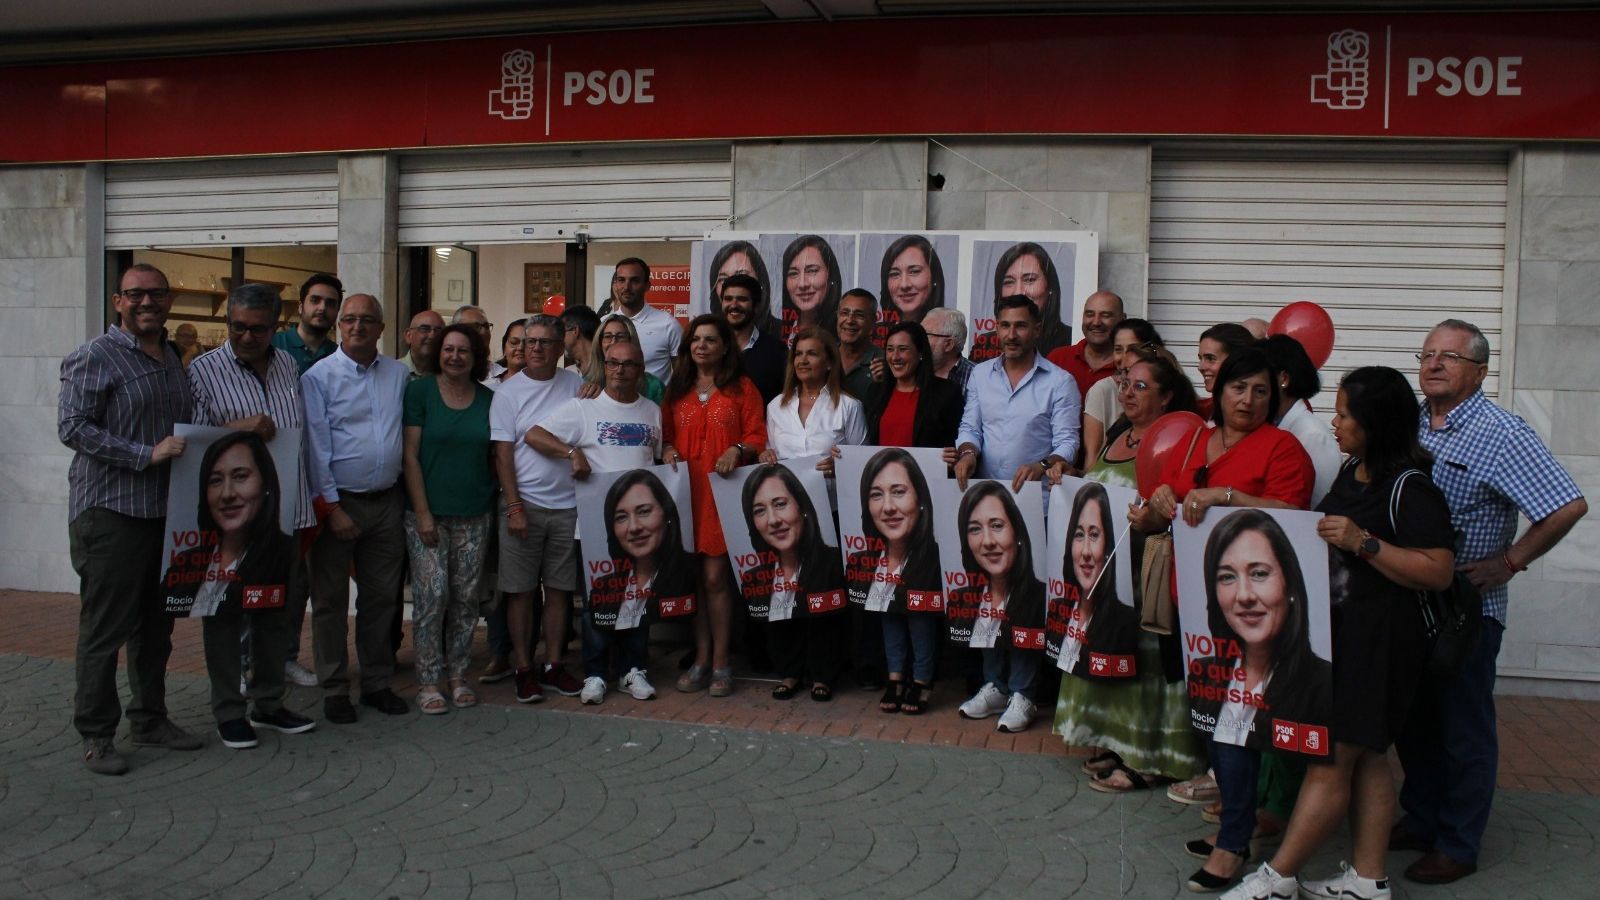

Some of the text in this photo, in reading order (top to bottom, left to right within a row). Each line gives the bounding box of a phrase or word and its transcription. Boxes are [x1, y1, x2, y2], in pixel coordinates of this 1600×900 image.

[1407, 56, 1523, 96] PSOE
[563, 68, 655, 106] PSOE
[783, 307, 799, 321] TA
[875, 309, 901, 322] OTA
[975, 318, 999, 331] VO
[172, 529, 219, 547] VOTA
[844, 534, 886, 551] VOTA
[170, 549, 223, 568] lo que
[588, 558, 634, 574] VOTA
[734, 550, 778, 568] VOTA
[845, 550, 889, 568] lo que
[590, 575, 638, 590] lo que
[739, 567, 785, 584] lo que
[944, 571, 987, 587] VOTA
[946, 587, 993, 604] lo que
[1048, 577, 1080, 602] VOTA
[1048, 595, 1081, 621] lo que
[1014, 630, 1027, 638] PSOE
[1185, 632, 1242, 659] VOTA
[1091, 656, 1107, 665] PSOE
[1187, 654, 1248, 683] lo que
[1275, 724, 1294, 736] PSOE
